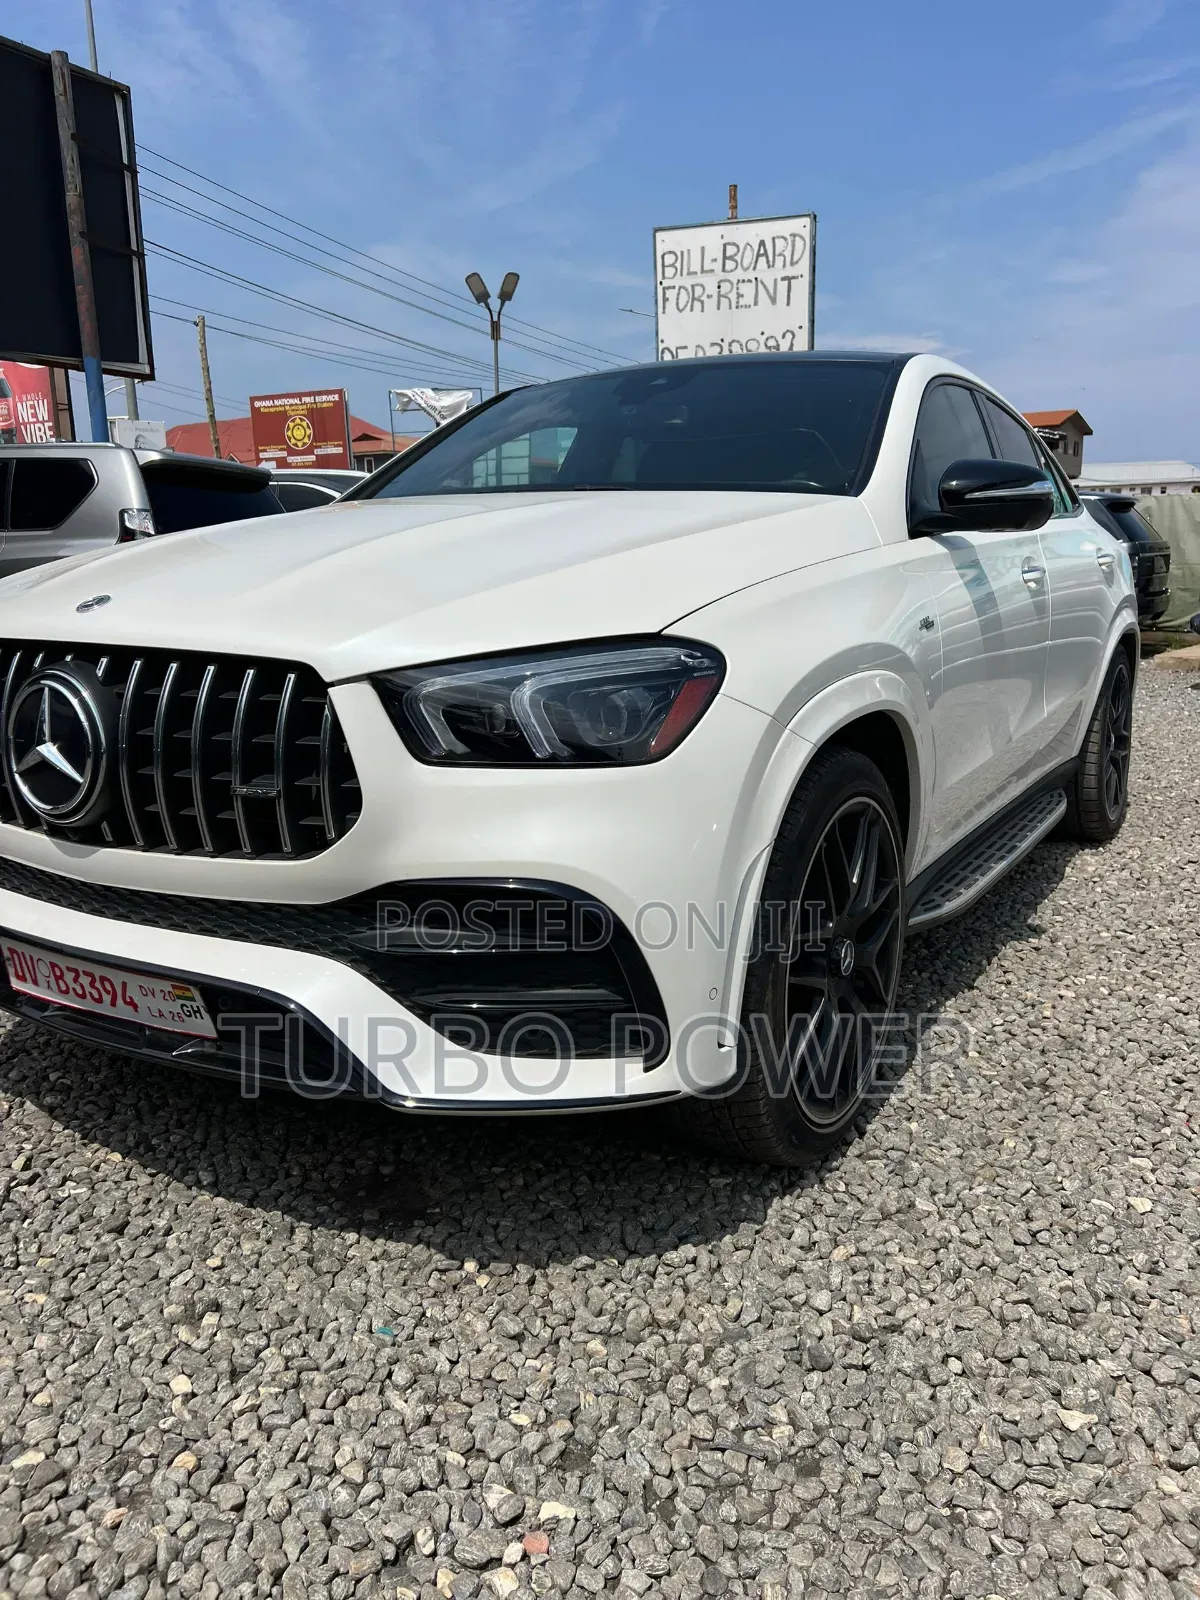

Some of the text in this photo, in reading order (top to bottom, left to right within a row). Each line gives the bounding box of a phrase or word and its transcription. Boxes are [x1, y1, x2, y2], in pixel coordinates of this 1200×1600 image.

[660, 233, 806, 281] BILL-BOARD
[661, 275, 800, 315] FOR-RENT
[22, 392, 43, 401] WHOLE
[254, 394, 339, 408] GHANA NATIONAL FIRE SERVICE
[16, 399, 49, 423] NEW
[21, 422, 55, 443] VIBE
[138, 984, 156, 999] DV
[147, 1005, 167, 1020] LA
[180, 1003, 204, 1020] GH
